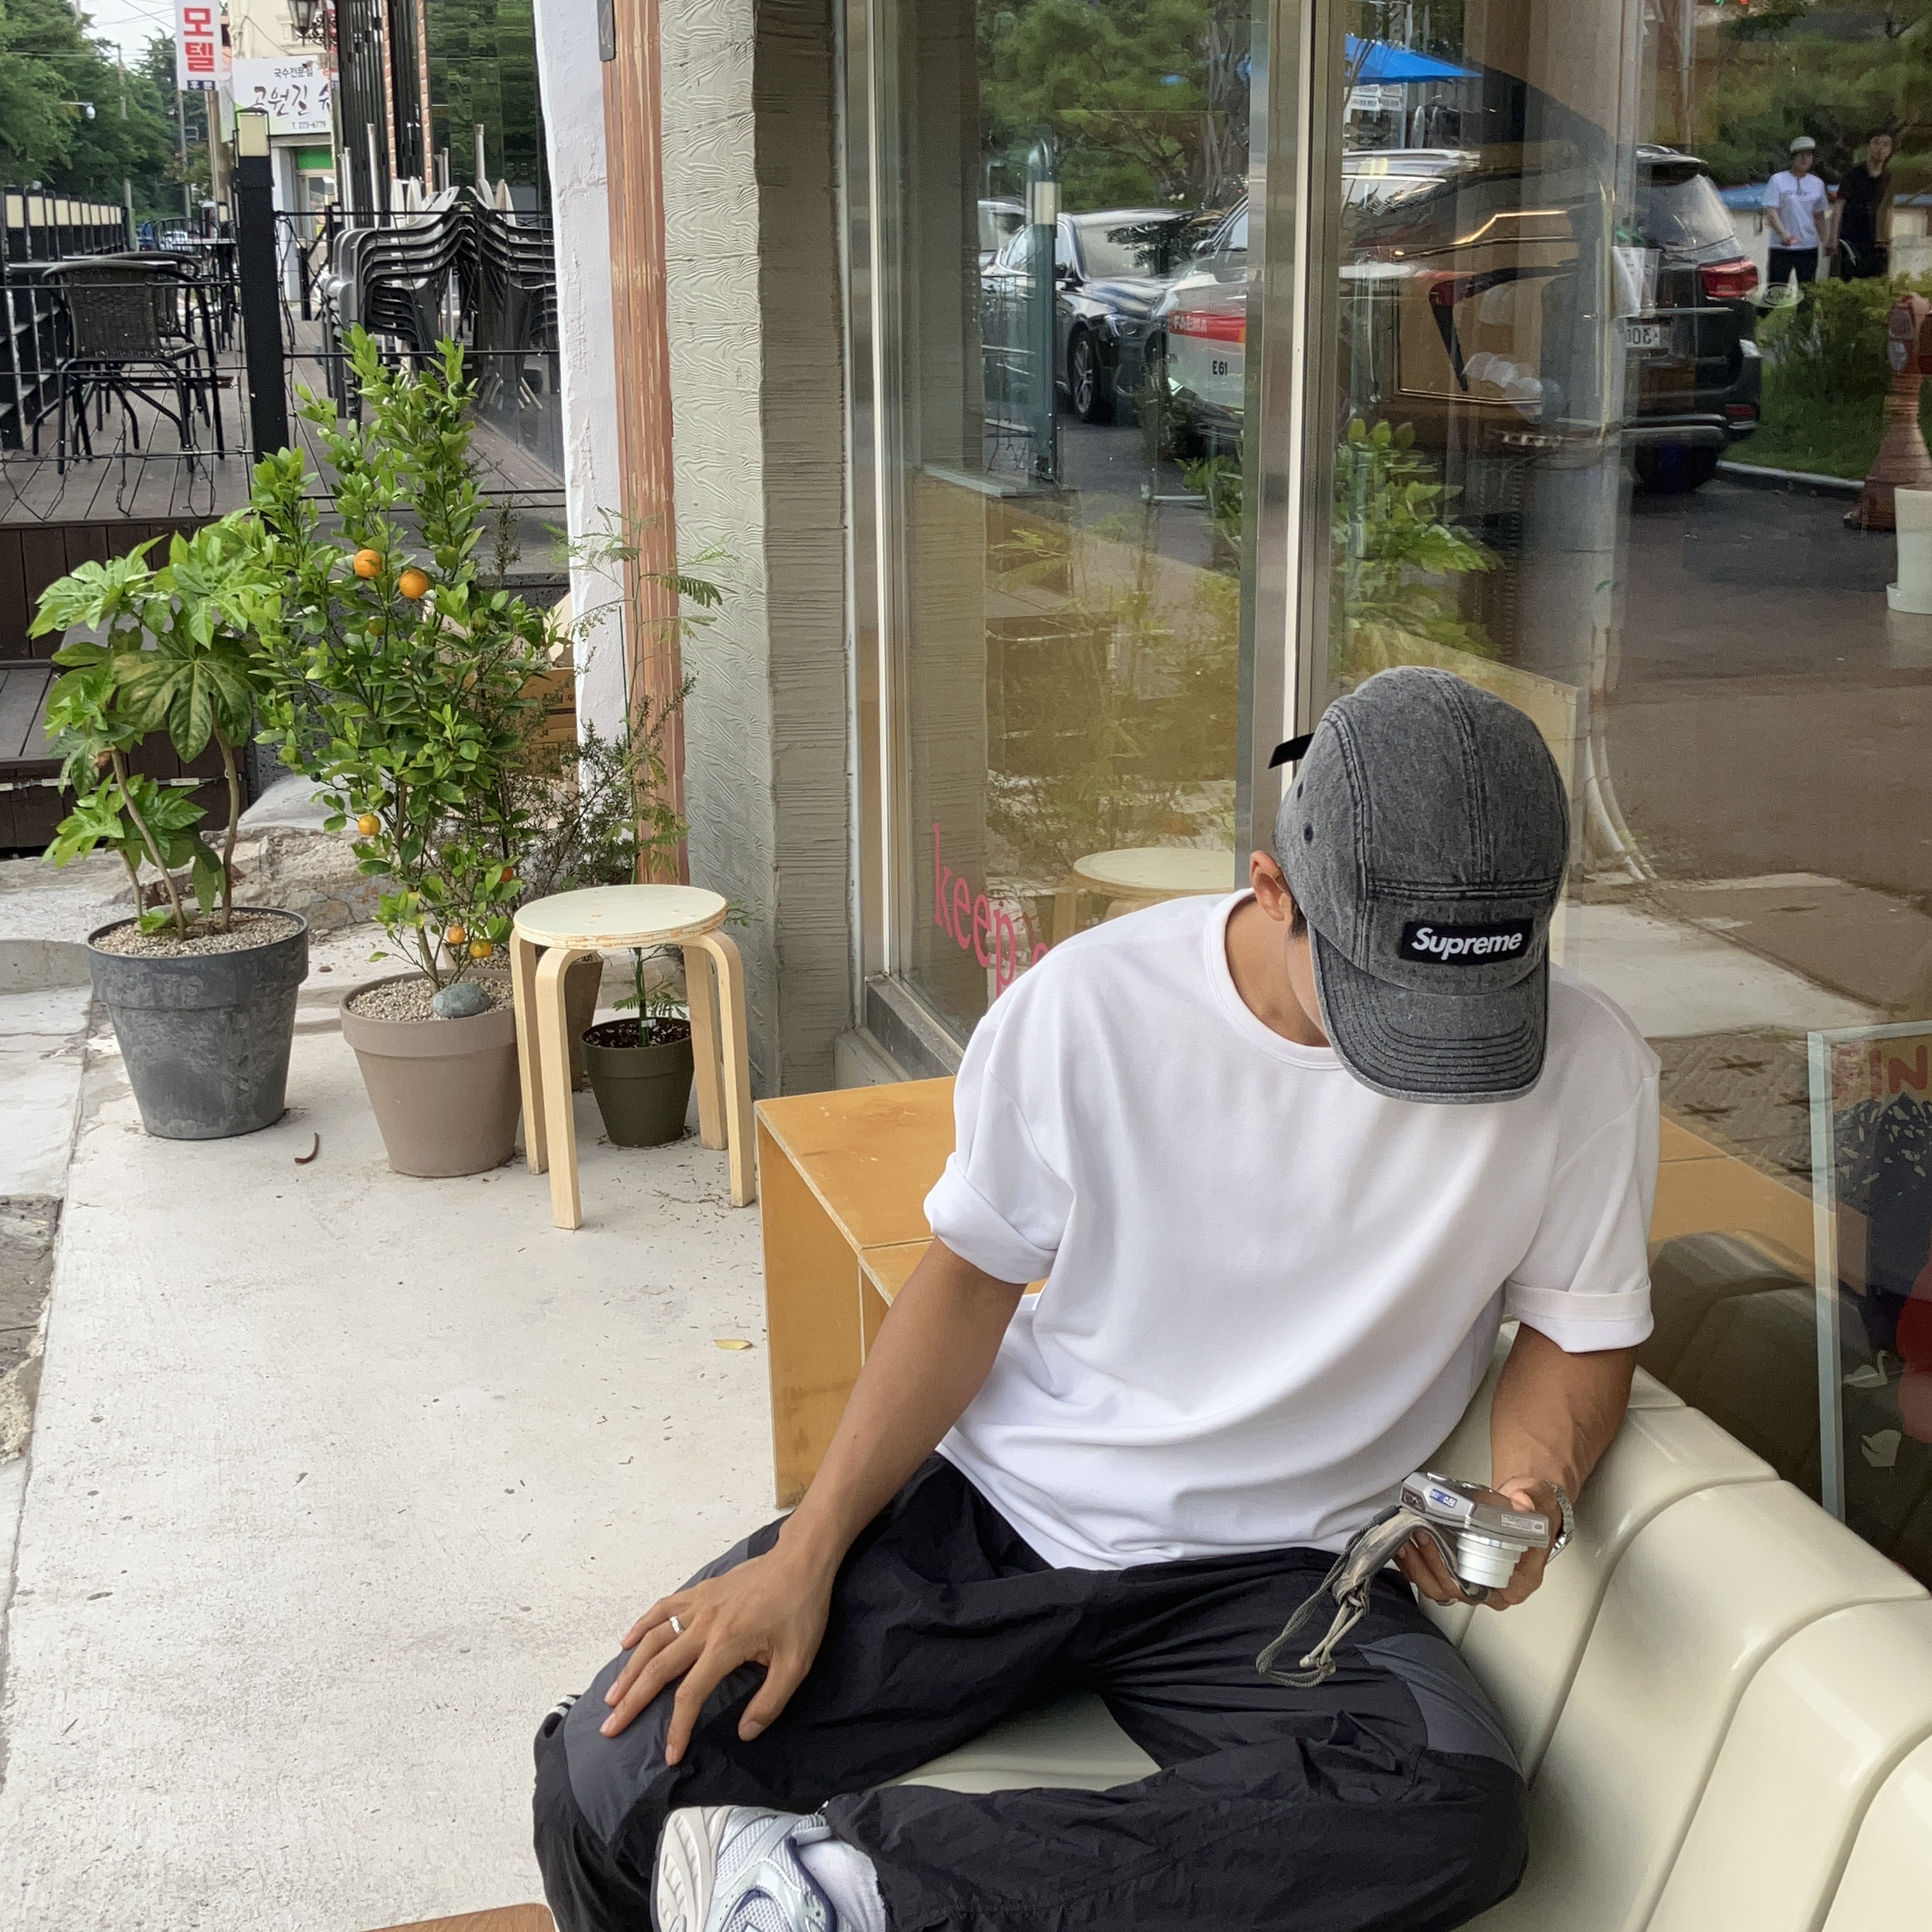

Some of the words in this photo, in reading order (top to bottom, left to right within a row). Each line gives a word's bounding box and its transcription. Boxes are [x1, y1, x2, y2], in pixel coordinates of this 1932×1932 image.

[183, 7, 215, 73] 모텔
[274, 66, 314, 79] 국수전문점
[1213, 360, 1228, 376] E61
[932, 823, 1016, 998] keep
[1411, 927, 1522, 960] Supreme
